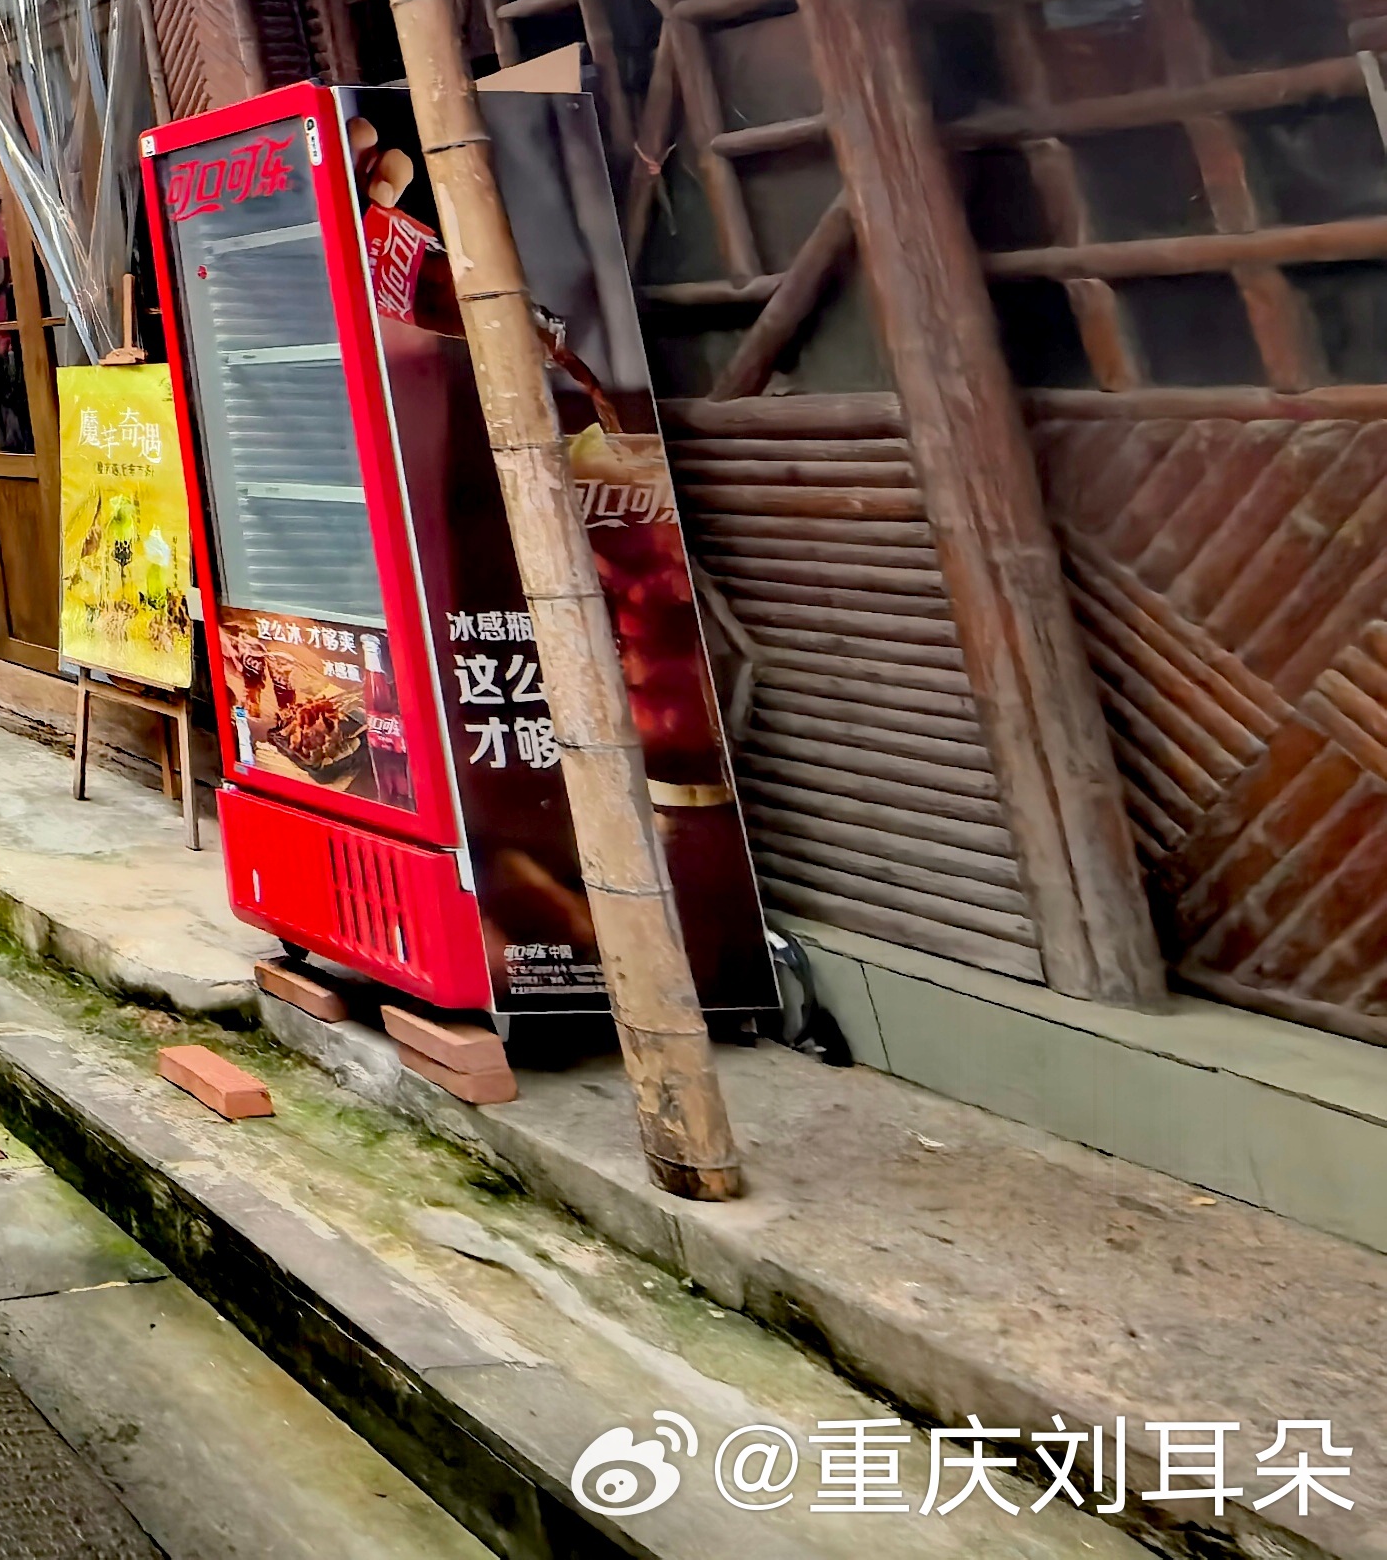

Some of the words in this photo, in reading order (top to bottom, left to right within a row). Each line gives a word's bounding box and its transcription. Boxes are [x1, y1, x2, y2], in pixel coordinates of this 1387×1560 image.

[166, 133, 296, 222] 可口可乐
[78, 406, 162, 463] 魔芋奇遇
[255, 617, 303, 645] 这么冰
[305, 626, 358, 655] 才够爽
[445, 611, 536, 641] 冰感瓶
